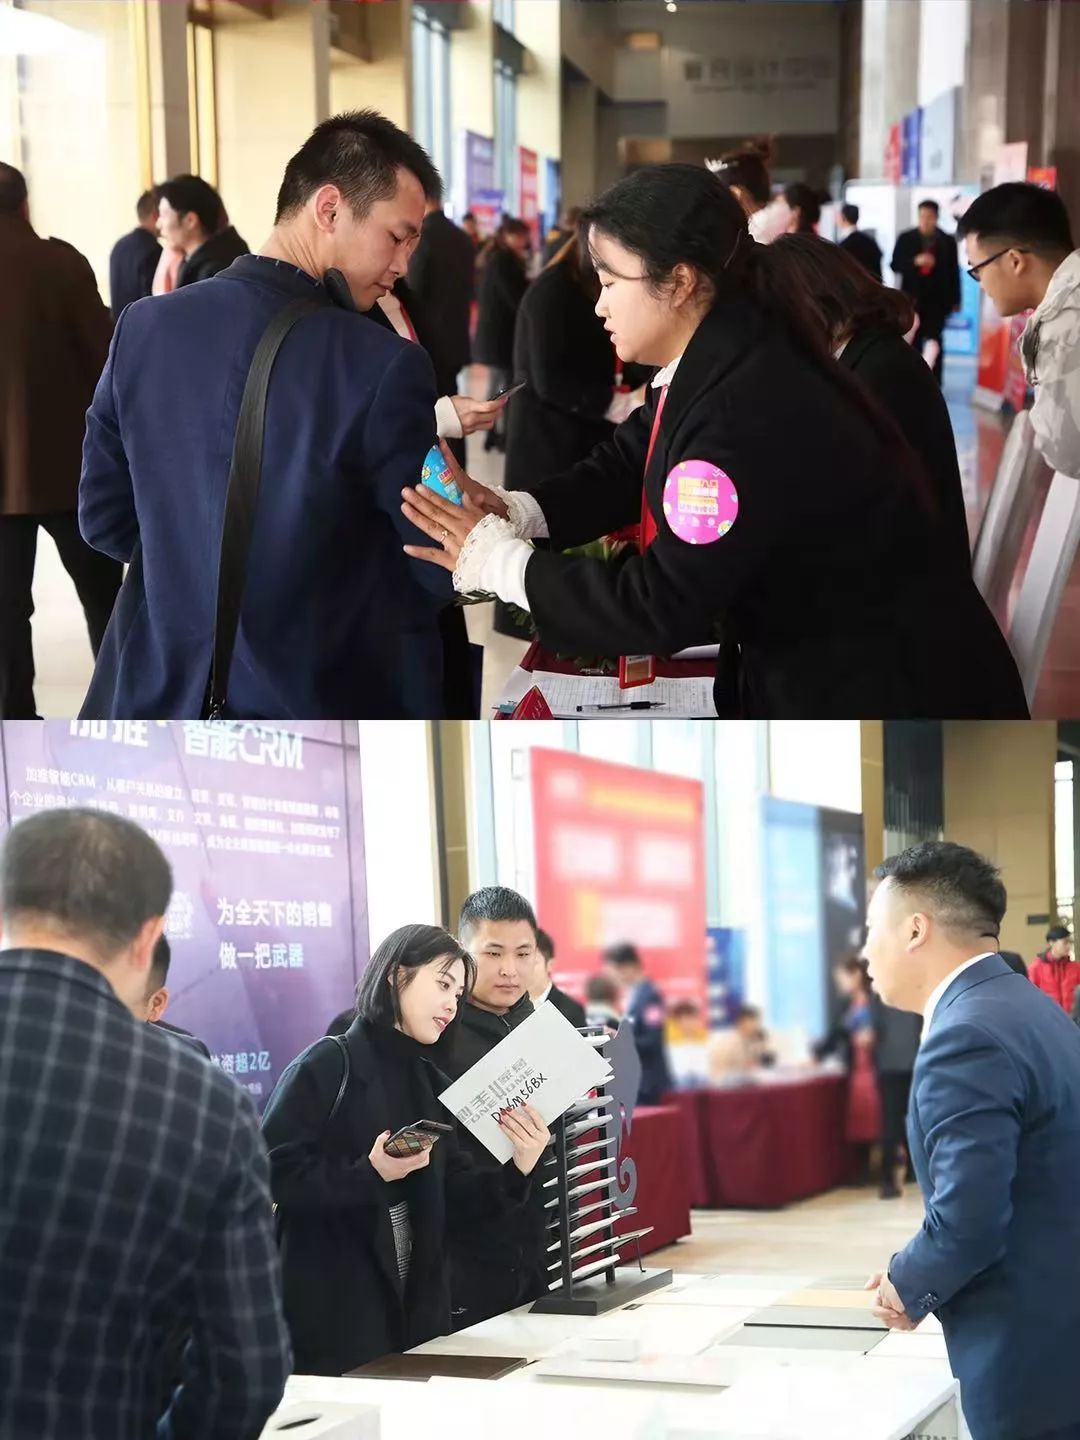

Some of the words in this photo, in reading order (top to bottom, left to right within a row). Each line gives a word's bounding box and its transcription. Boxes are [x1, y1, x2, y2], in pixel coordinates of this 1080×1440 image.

[217, 897, 332, 928] 为全天下的销售
[219, 941, 304, 970] 做一把武器
